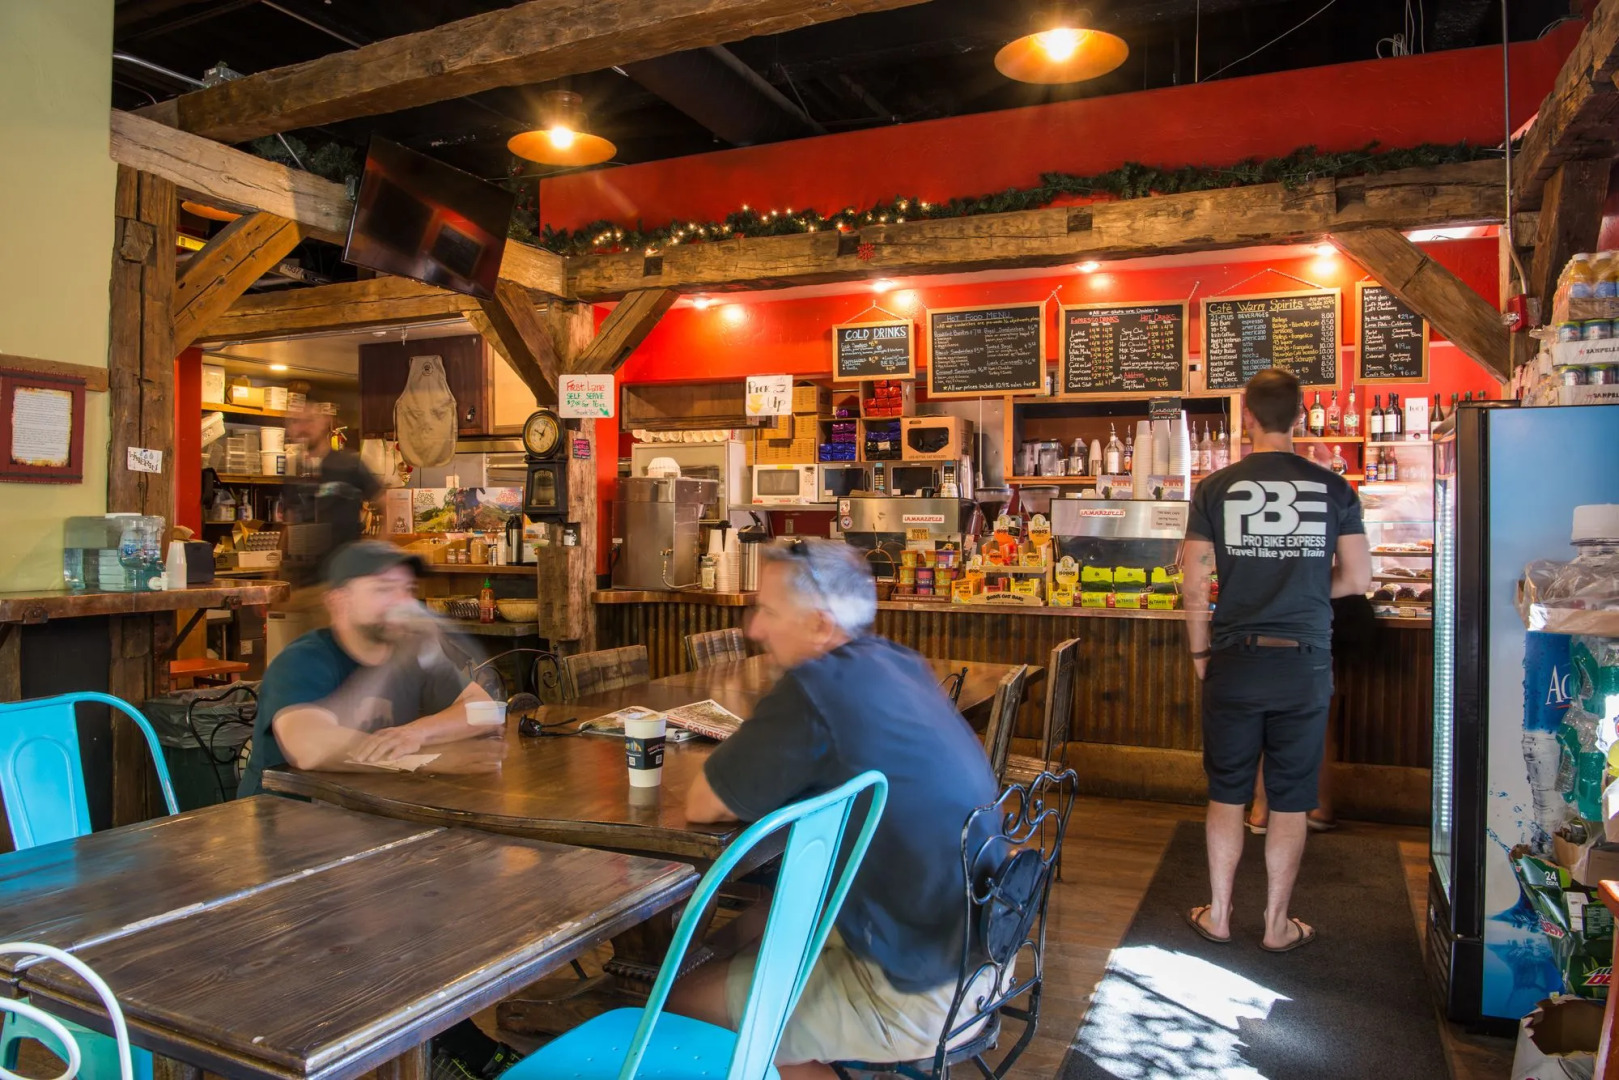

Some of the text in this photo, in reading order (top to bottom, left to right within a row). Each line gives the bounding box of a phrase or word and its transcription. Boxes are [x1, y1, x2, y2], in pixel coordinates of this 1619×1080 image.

[1208, 298, 1303, 314] Café Warm Spirits
[965, 313, 983, 321] FOOD
[986, 311, 1012, 319] MENU
[873, 326, 907, 338] DRINKS
[587, 380, 606, 391] Lane
[566, 392, 605, 400] SELF SERVE
[767, 395, 787, 412] Up
[1224, 480, 1327, 546] PBE
[1242, 535, 1326, 548] PRO BIKE EXPRESS
[1225, 546, 1325, 560] Travel like you Train
[1544, 870, 1557, 882] 24
